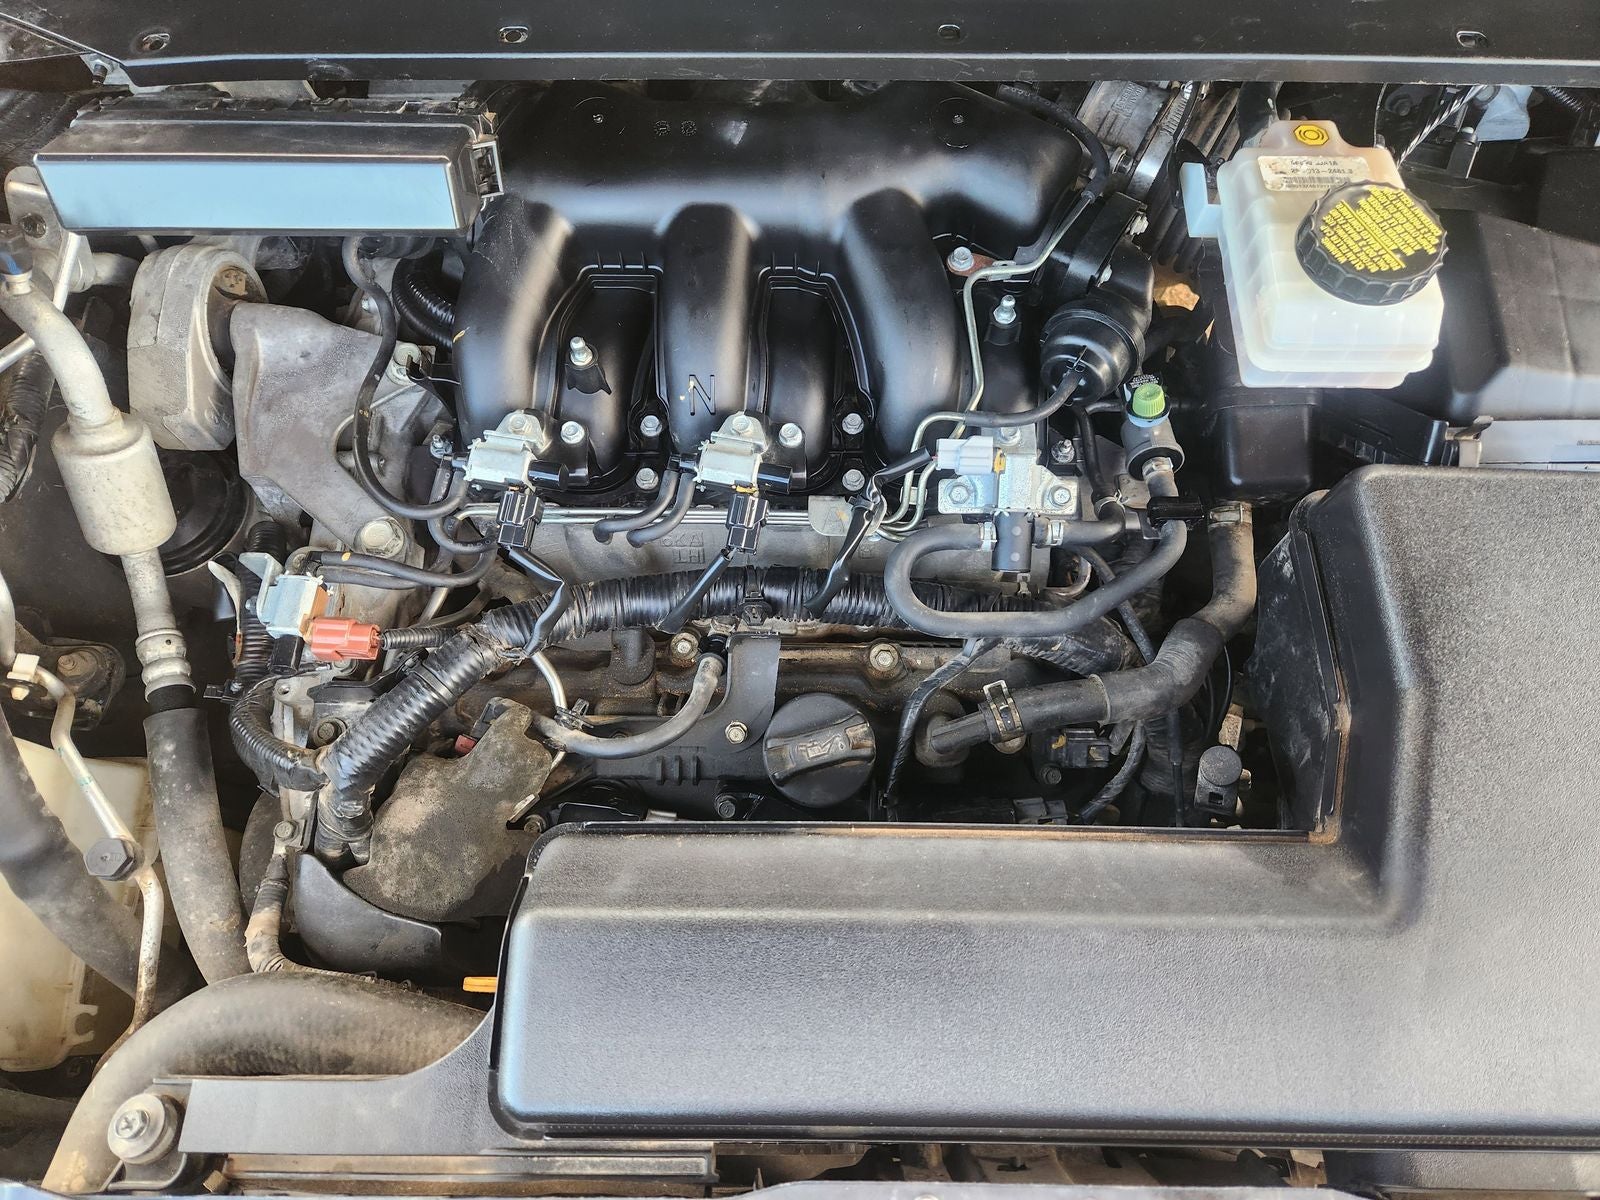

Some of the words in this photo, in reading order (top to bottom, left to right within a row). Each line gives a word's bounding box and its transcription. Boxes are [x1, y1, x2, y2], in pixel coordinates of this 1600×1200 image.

[1318, 223, 1334, 237] CAP
[1321, 214, 1336, 227] USE
[1340, 222, 1362, 242] BRAKE
[1358, 229, 1383, 251] SEALED
[1399, 230, 1421, 251] AVANT
[1423, 231, 1439, 245] DOT
[1344, 250, 1366, 270] CLEAN
[1361, 244, 1377, 258] DOT
[1355, 250, 1379, 273] BEFORE
[1371, 255, 1390, 271] ONLY
[1380, 252, 1401, 271] FROM
[689, 374, 716, 416] N
